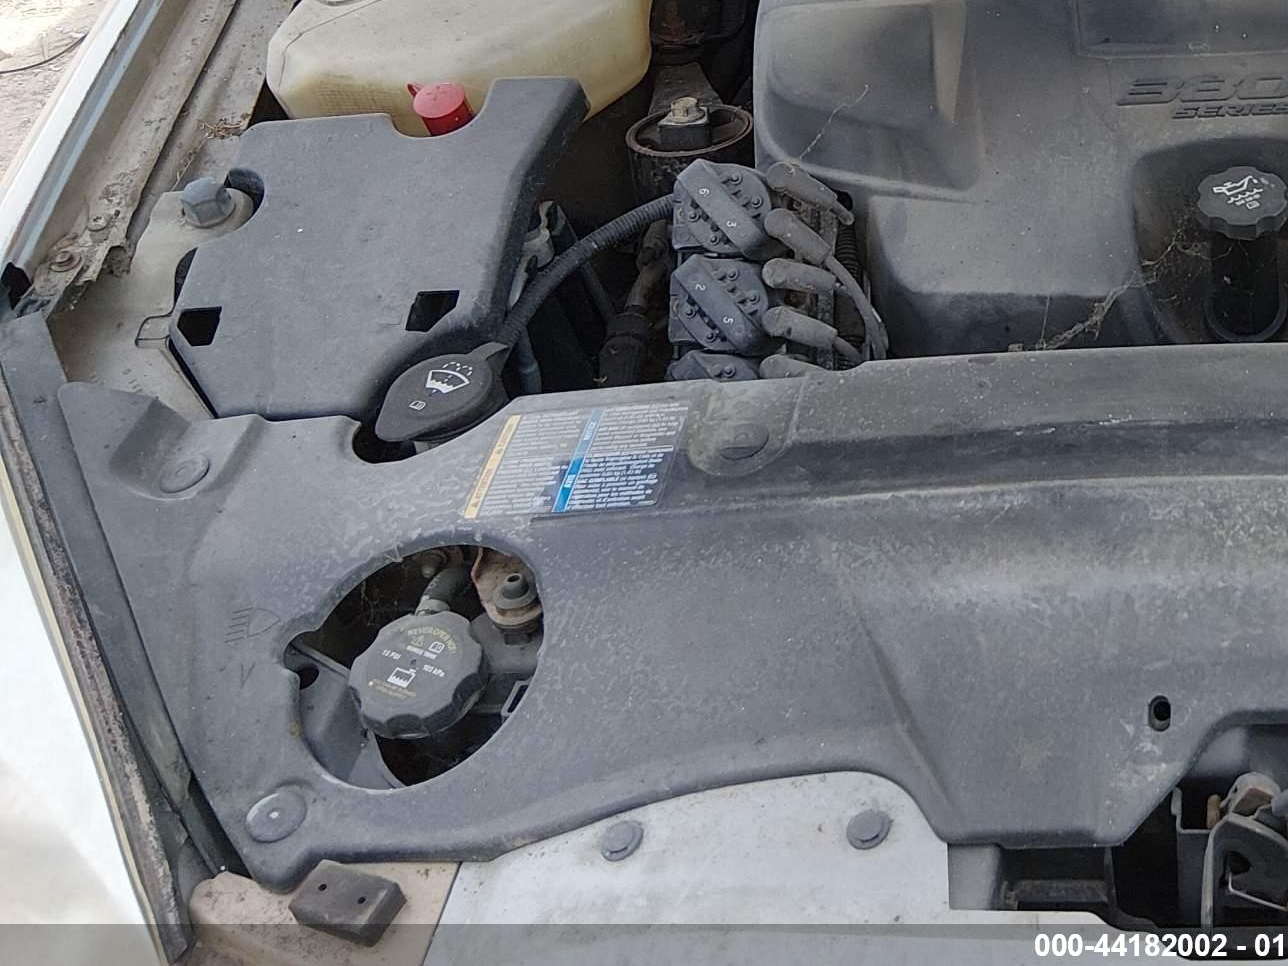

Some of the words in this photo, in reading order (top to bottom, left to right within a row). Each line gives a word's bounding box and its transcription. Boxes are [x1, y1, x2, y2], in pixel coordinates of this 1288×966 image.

[698, 187, 710, 196] 6
[726, 219, 738, 228] 3
[695, 283, 707, 292] 2
[722, 316, 734, 325] 5
